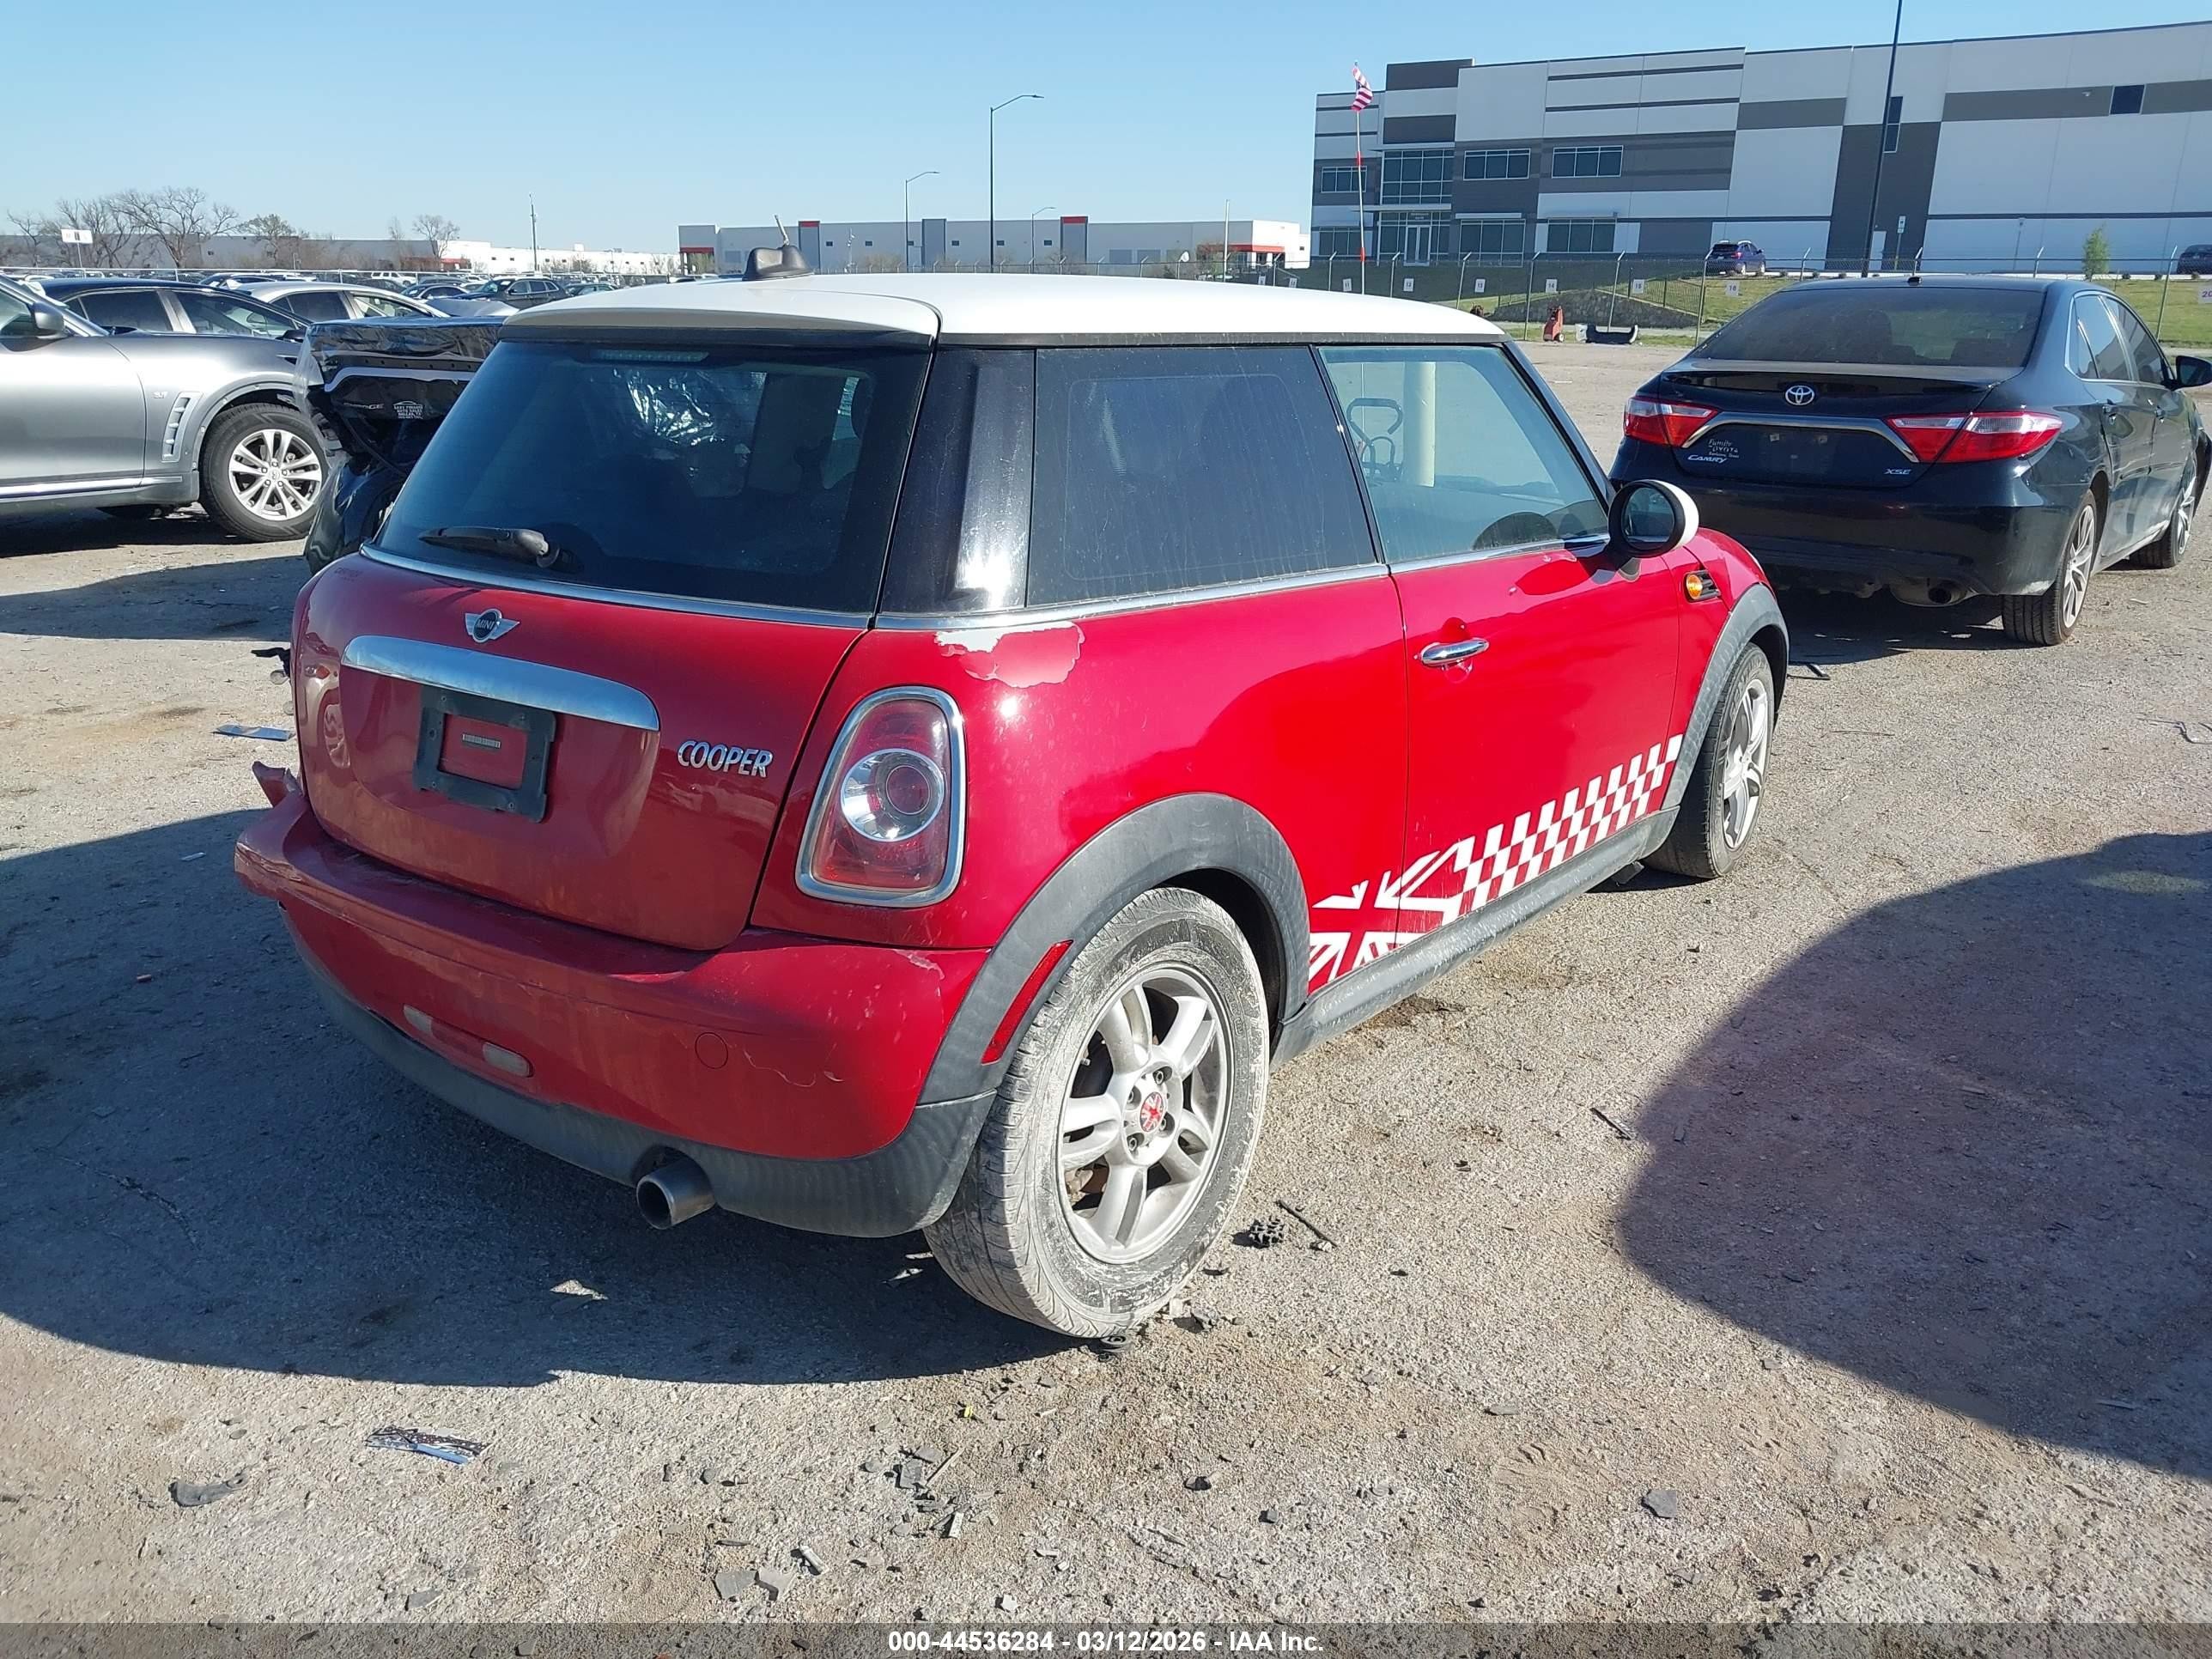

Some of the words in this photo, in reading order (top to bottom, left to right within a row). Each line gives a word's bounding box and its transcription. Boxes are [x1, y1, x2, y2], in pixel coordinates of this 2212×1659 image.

[1687, 454, 1727, 464] CAMRY
[477, 618, 495, 631] MINI
[678, 740, 773, 778] COOPER
